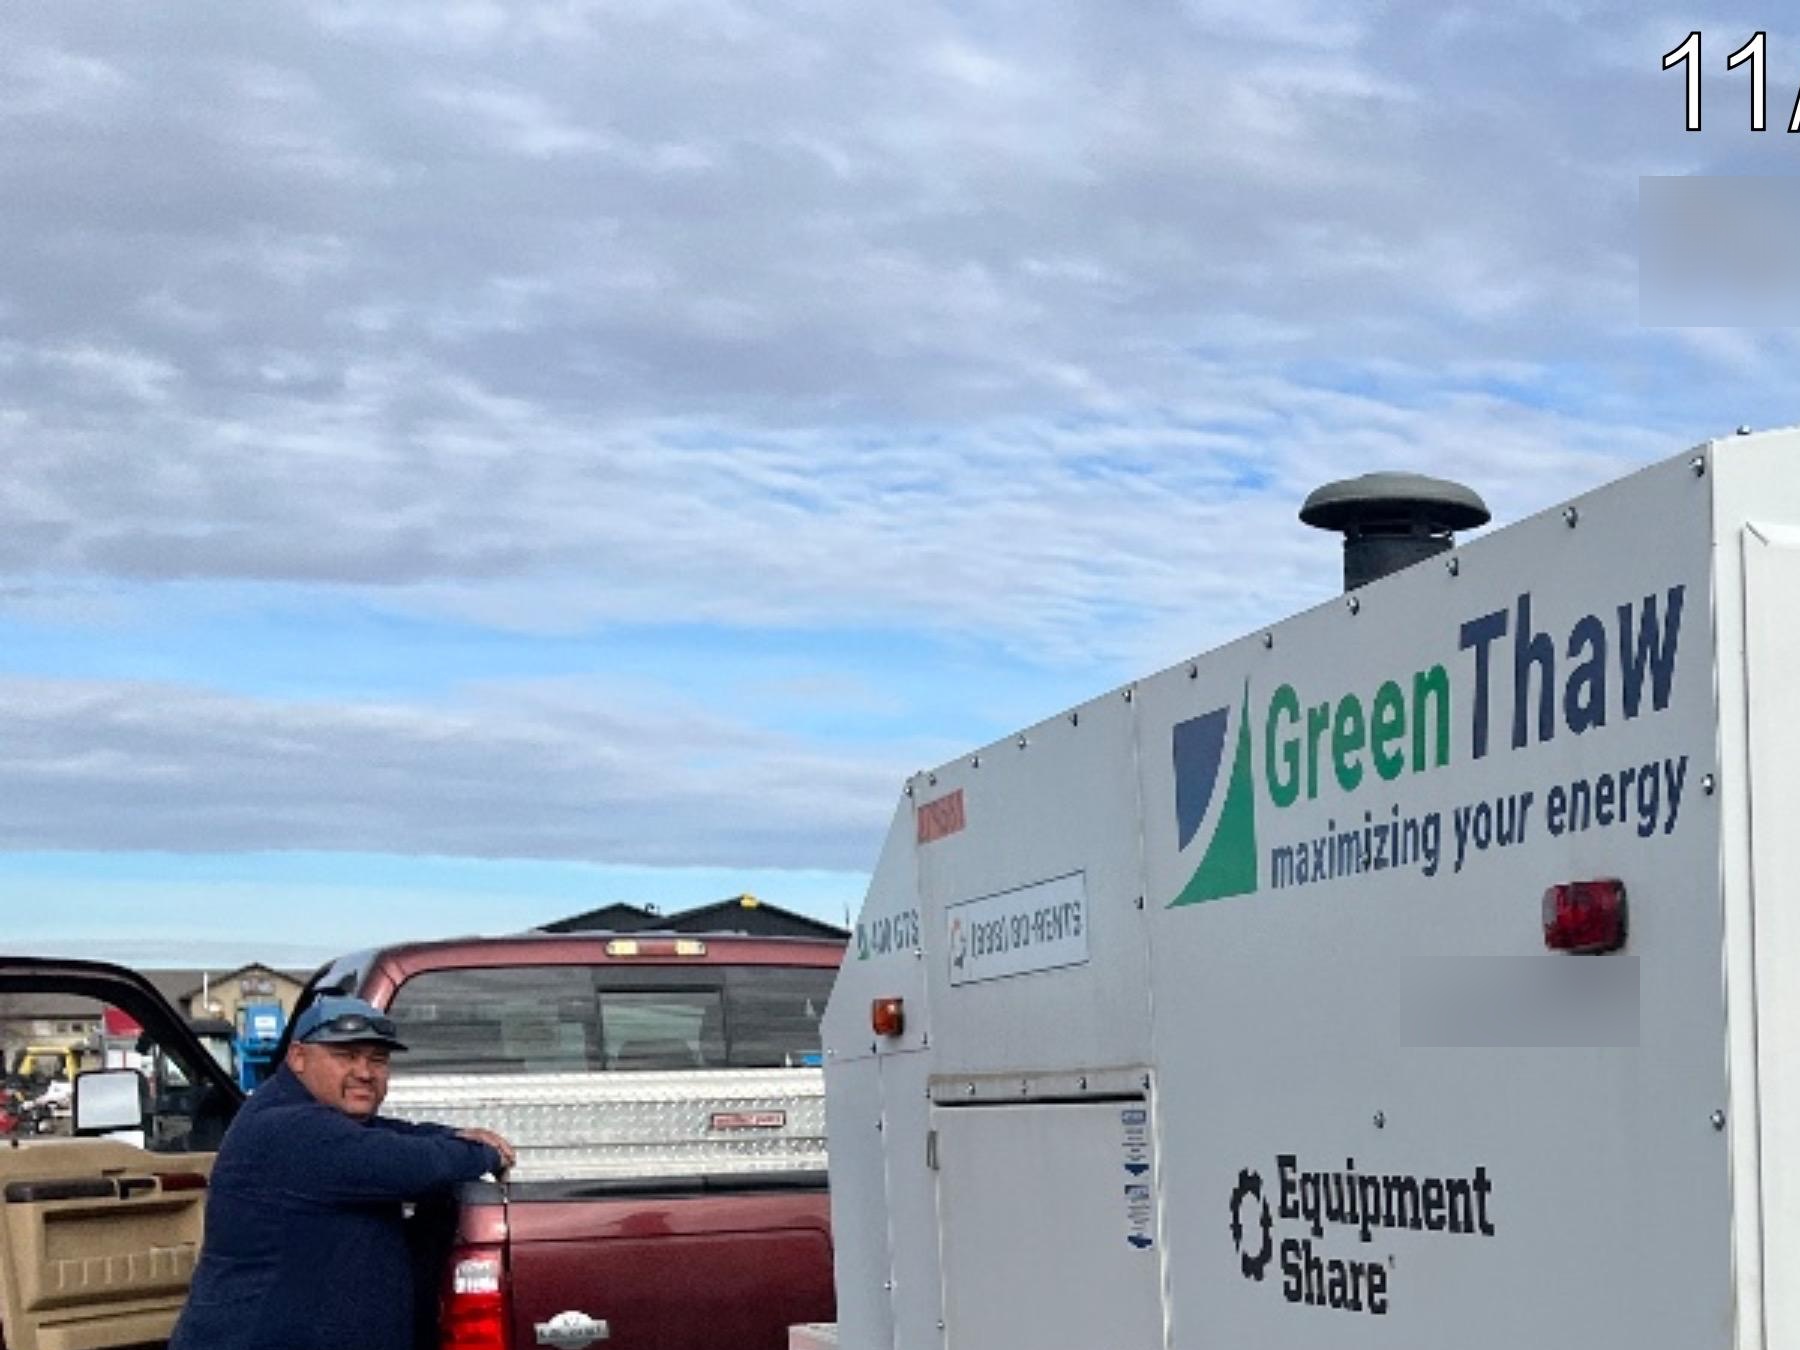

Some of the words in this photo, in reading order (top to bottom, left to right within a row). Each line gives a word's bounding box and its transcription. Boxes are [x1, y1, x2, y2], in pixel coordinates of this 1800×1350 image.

[1271, 805, 1441, 889] maximizing
[1453, 790, 1534, 873] your
[1547, 755, 1689, 837] energy
[1275, 1154, 1496, 1242] Equipment
